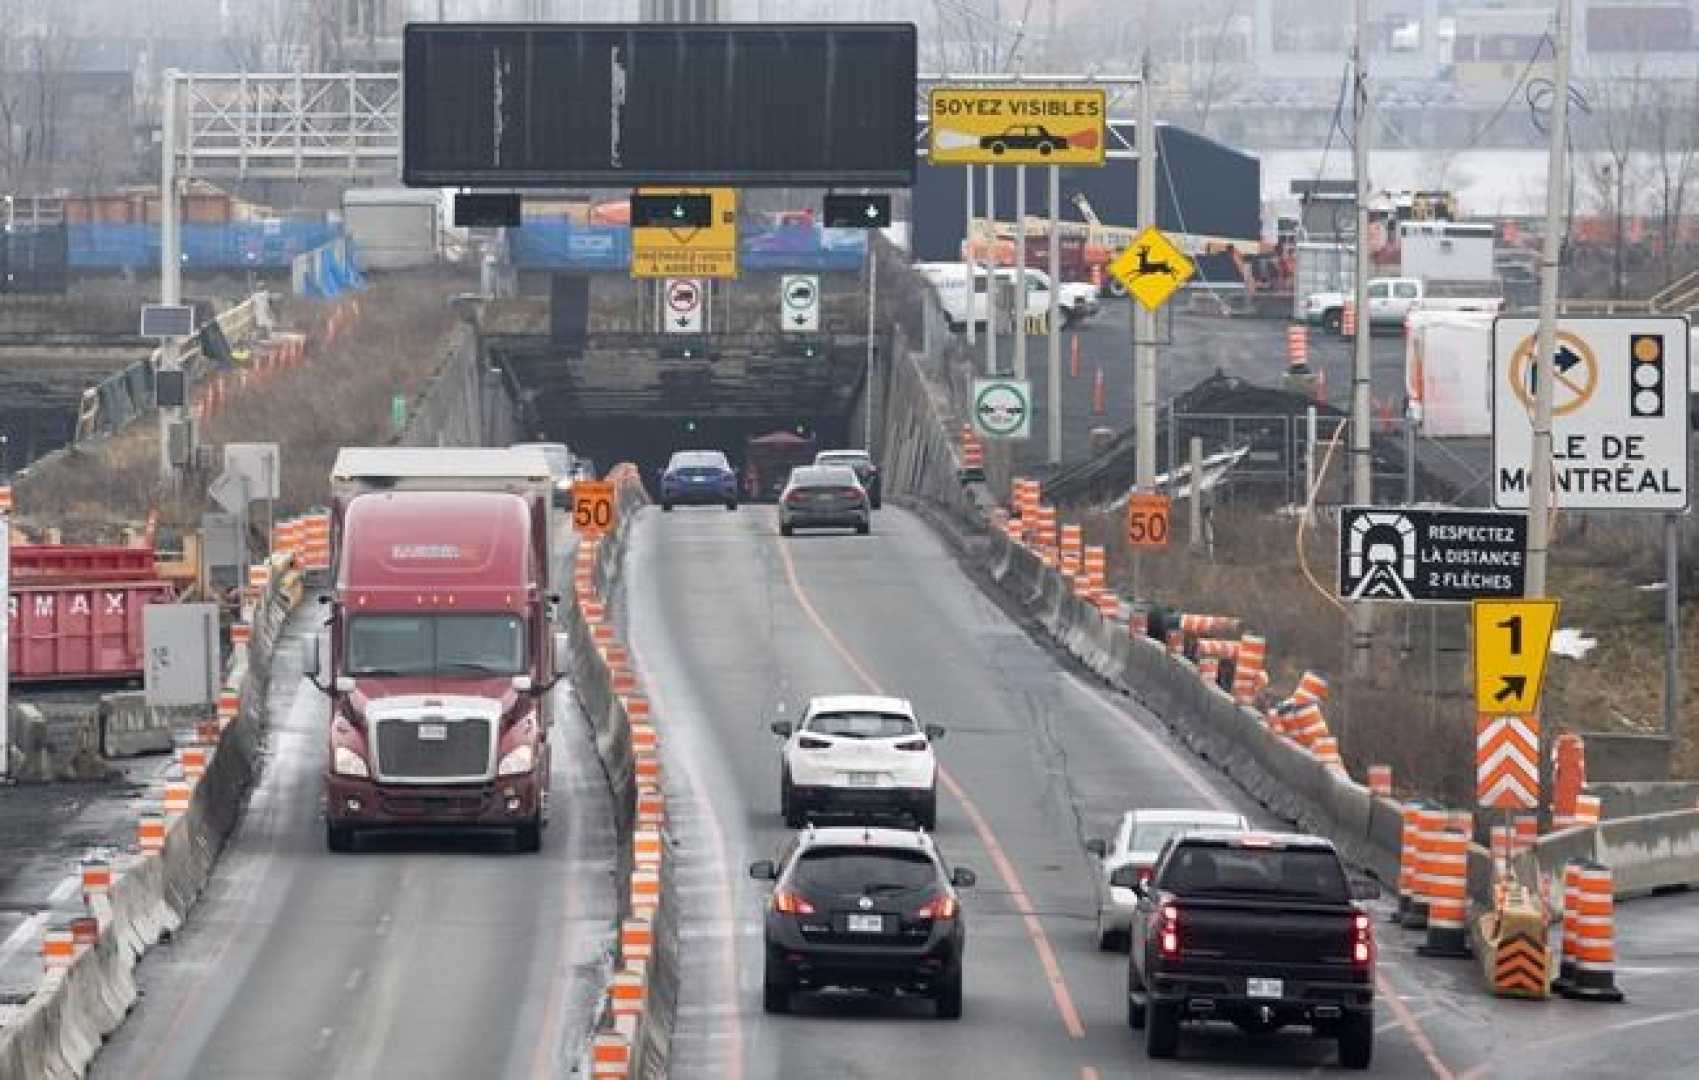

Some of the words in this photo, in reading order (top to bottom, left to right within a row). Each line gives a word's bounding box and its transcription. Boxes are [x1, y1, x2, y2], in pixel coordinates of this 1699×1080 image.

[935, 99, 1002, 115] SOYEZ
[1009, 99, 1099, 115] VISIBLES
[1602, 435, 1645, 460] DE
[1500, 463, 1682, 493] MNTRÉAL
[575, 499, 611, 527] 50
[1129, 512, 1167, 541] 50
[1429, 525, 1515, 542] RESPECTEZ
[1445, 548, 1521, 566] DISTANCE
[1429, 572, 1441, 587] 2
[1496, 616, 1522, 655] 1
